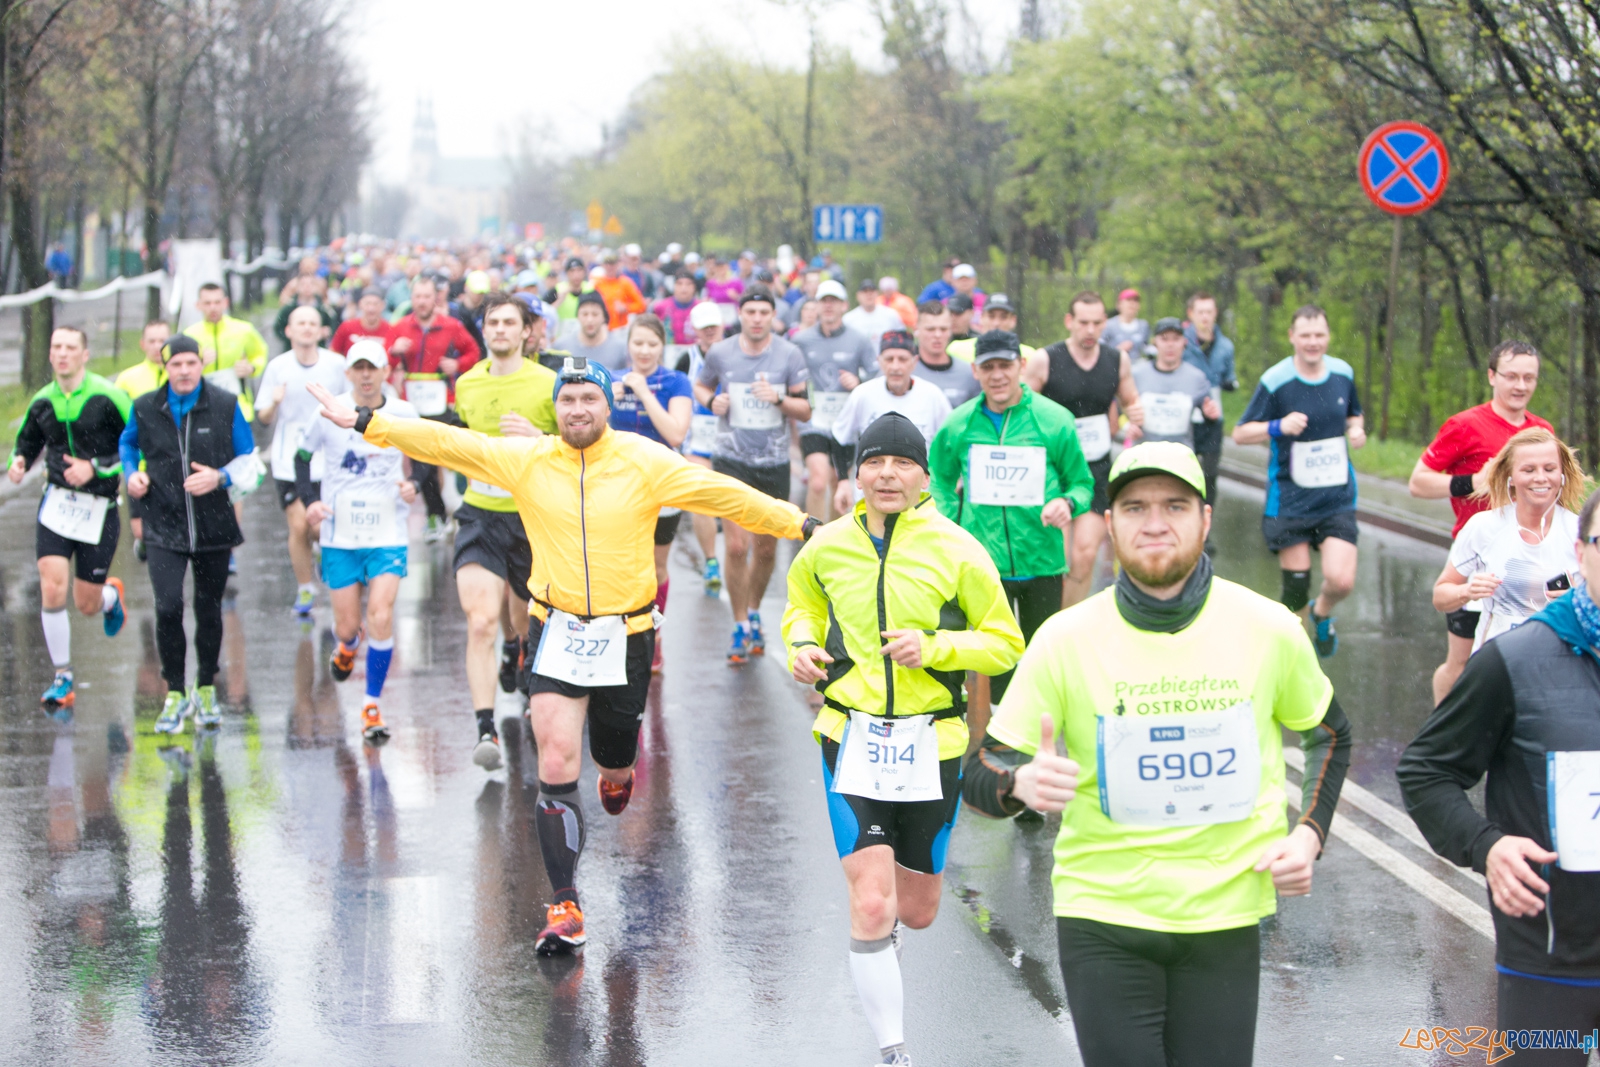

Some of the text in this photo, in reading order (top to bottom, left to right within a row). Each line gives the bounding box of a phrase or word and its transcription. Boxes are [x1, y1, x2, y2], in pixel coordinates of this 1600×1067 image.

[985, 465, 1028, 481] 11077
[351, 512, 380, 525] 1691
[564, 635, 610, 657] 2227
[867, 741, 915, 765] 3114
[1138, 748, 1236, 781] 6902
[1174, 784, 1205, 793] Daniel
